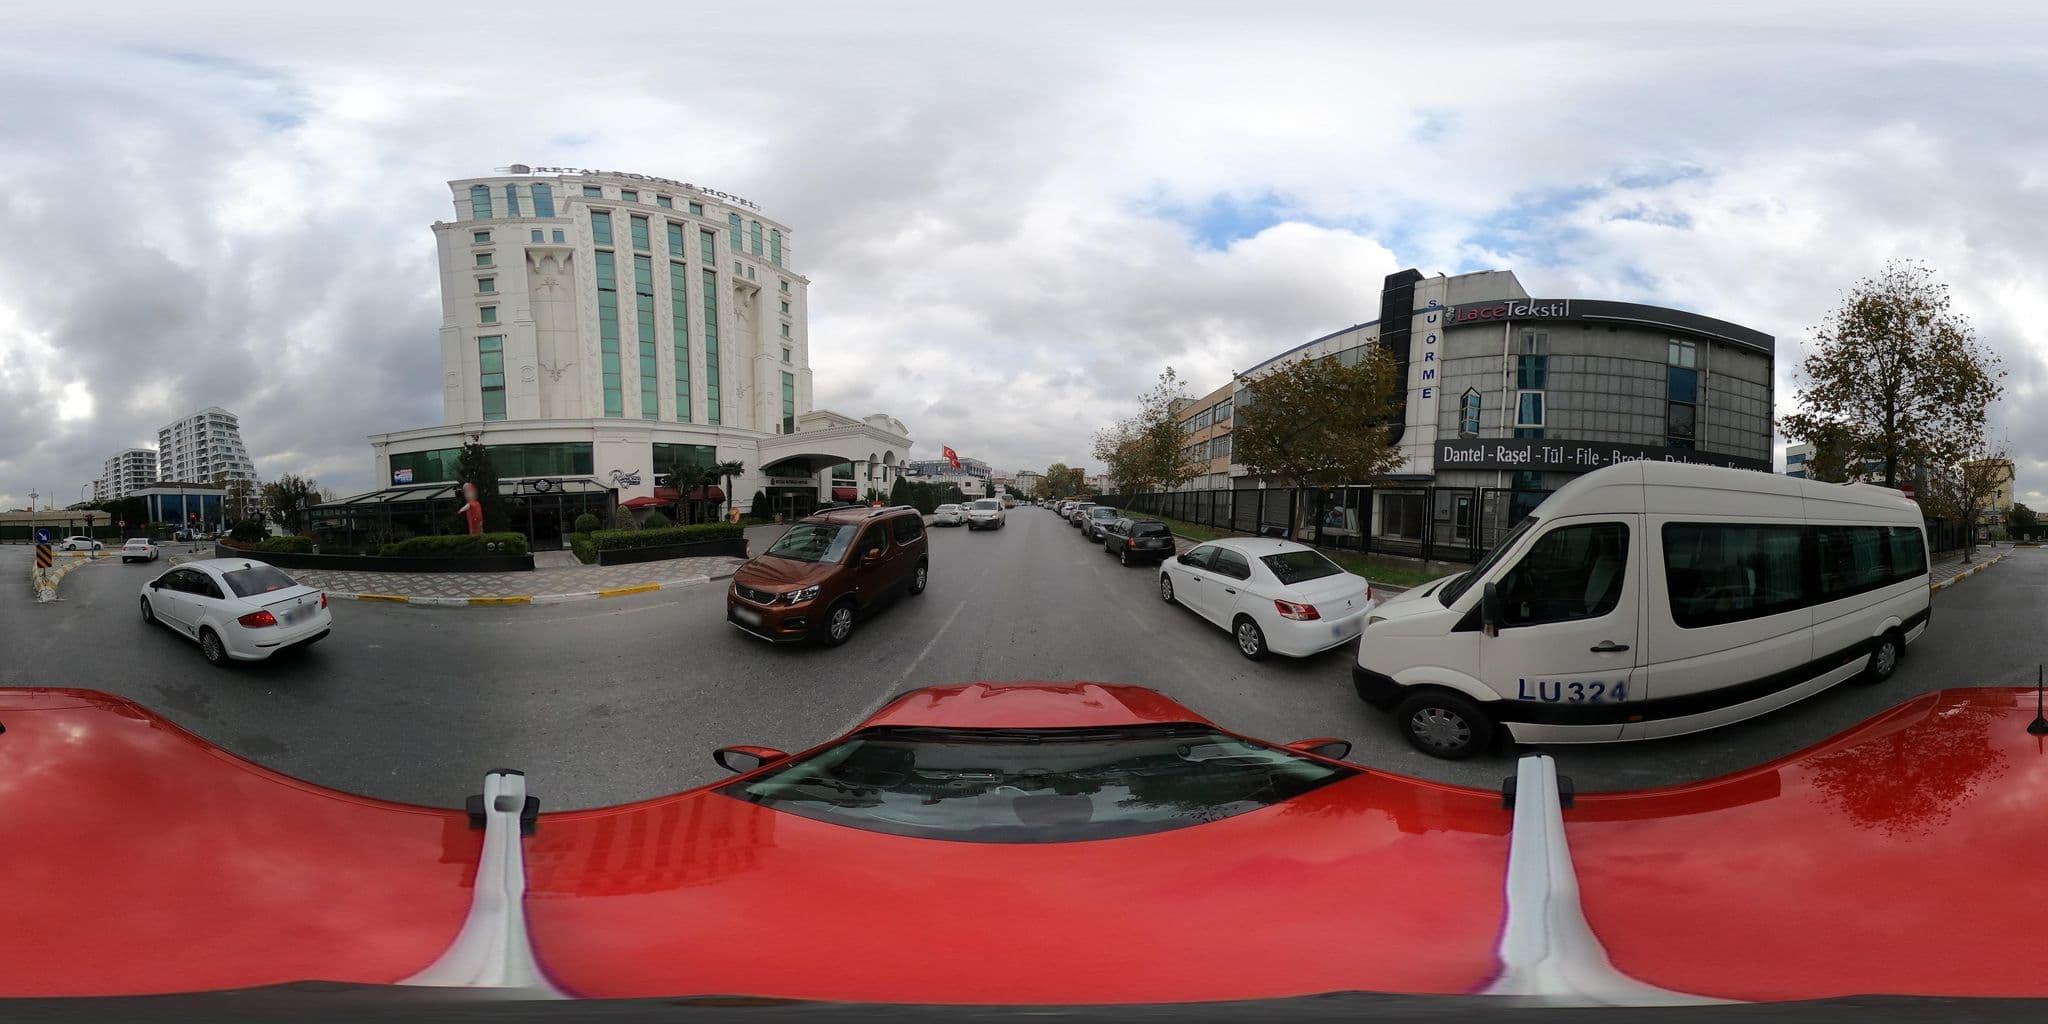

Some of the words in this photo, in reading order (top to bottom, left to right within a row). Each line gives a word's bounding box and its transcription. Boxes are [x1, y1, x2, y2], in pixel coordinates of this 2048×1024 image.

[702, 187, 757, 208] HOTEL
[1444, 445, 1484, 462] Dantel
[1496, 445, 1531, 465] Raşel
[1576, 448, 1599, 465] File
